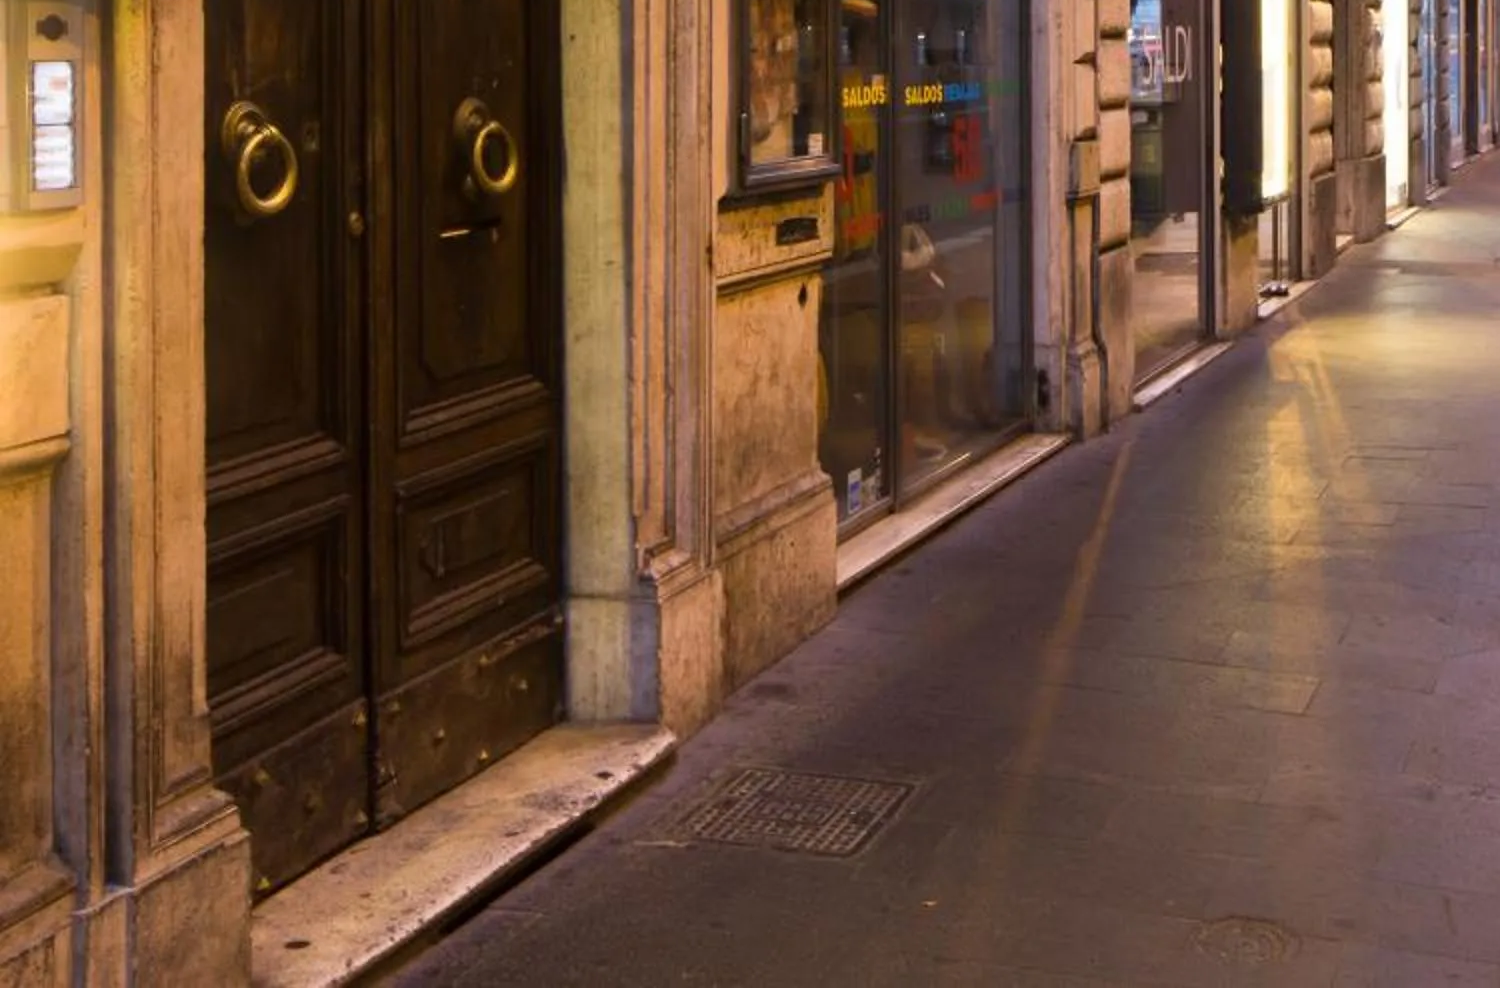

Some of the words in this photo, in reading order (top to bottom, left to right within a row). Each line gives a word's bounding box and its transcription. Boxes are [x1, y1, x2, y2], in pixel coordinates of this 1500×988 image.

[1142, 25, 1192, 85] SALDI
[842, 85, 886, 108] SALDOS
[905, 83, 943, 106] SALDOS
